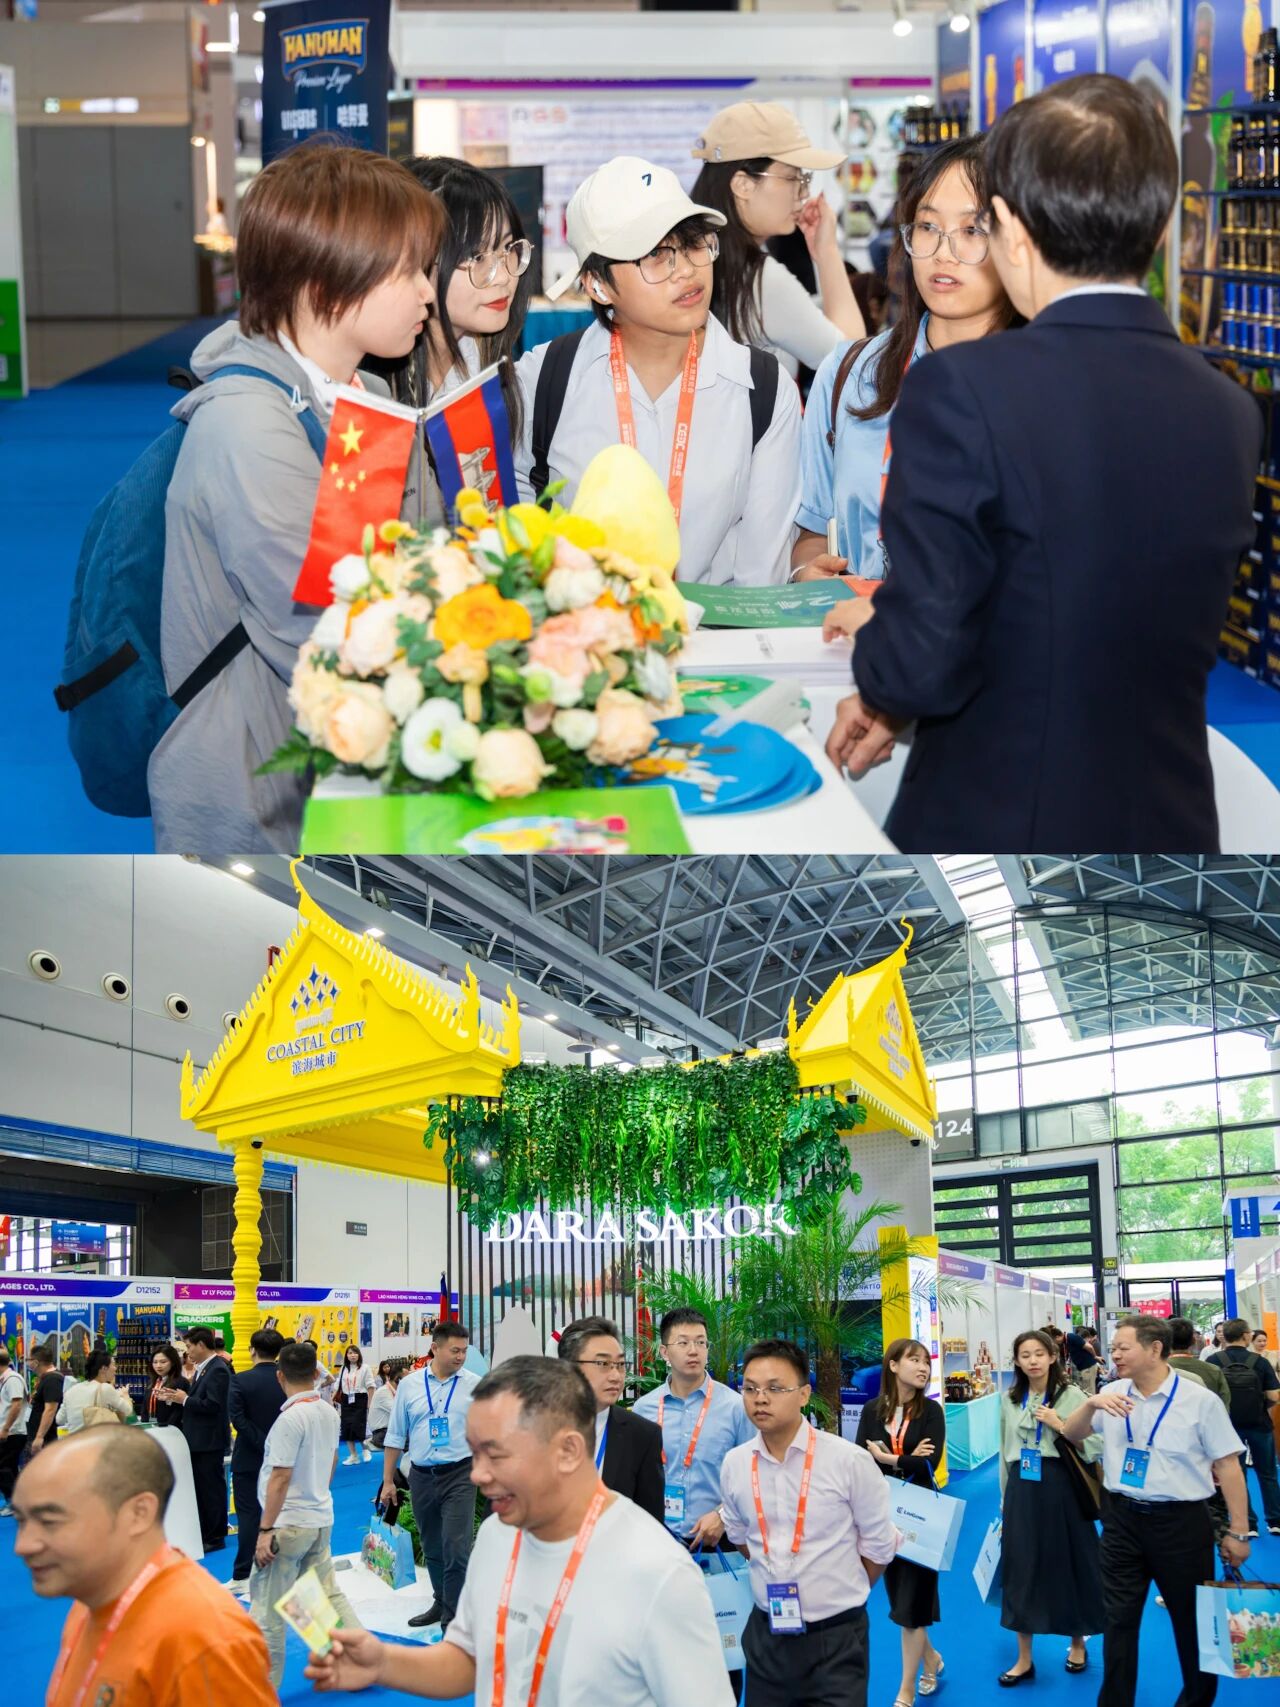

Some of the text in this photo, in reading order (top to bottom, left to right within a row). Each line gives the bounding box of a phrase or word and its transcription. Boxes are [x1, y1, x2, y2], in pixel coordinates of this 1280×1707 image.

[284, 26, 363, 63] HANUMAN
[641, 173, 652, 187] 7
[267, 1032, 325, 1063] COASTAL
[330, 1020, 366, 1044] CITY
[292, 1051, 337, 1075] 滨海城市
[485, 1210, 626, 1243] DARA
[136, 1286, 161, 1294] D12152
[176, 1315, 225, 1323] CRACKERS
